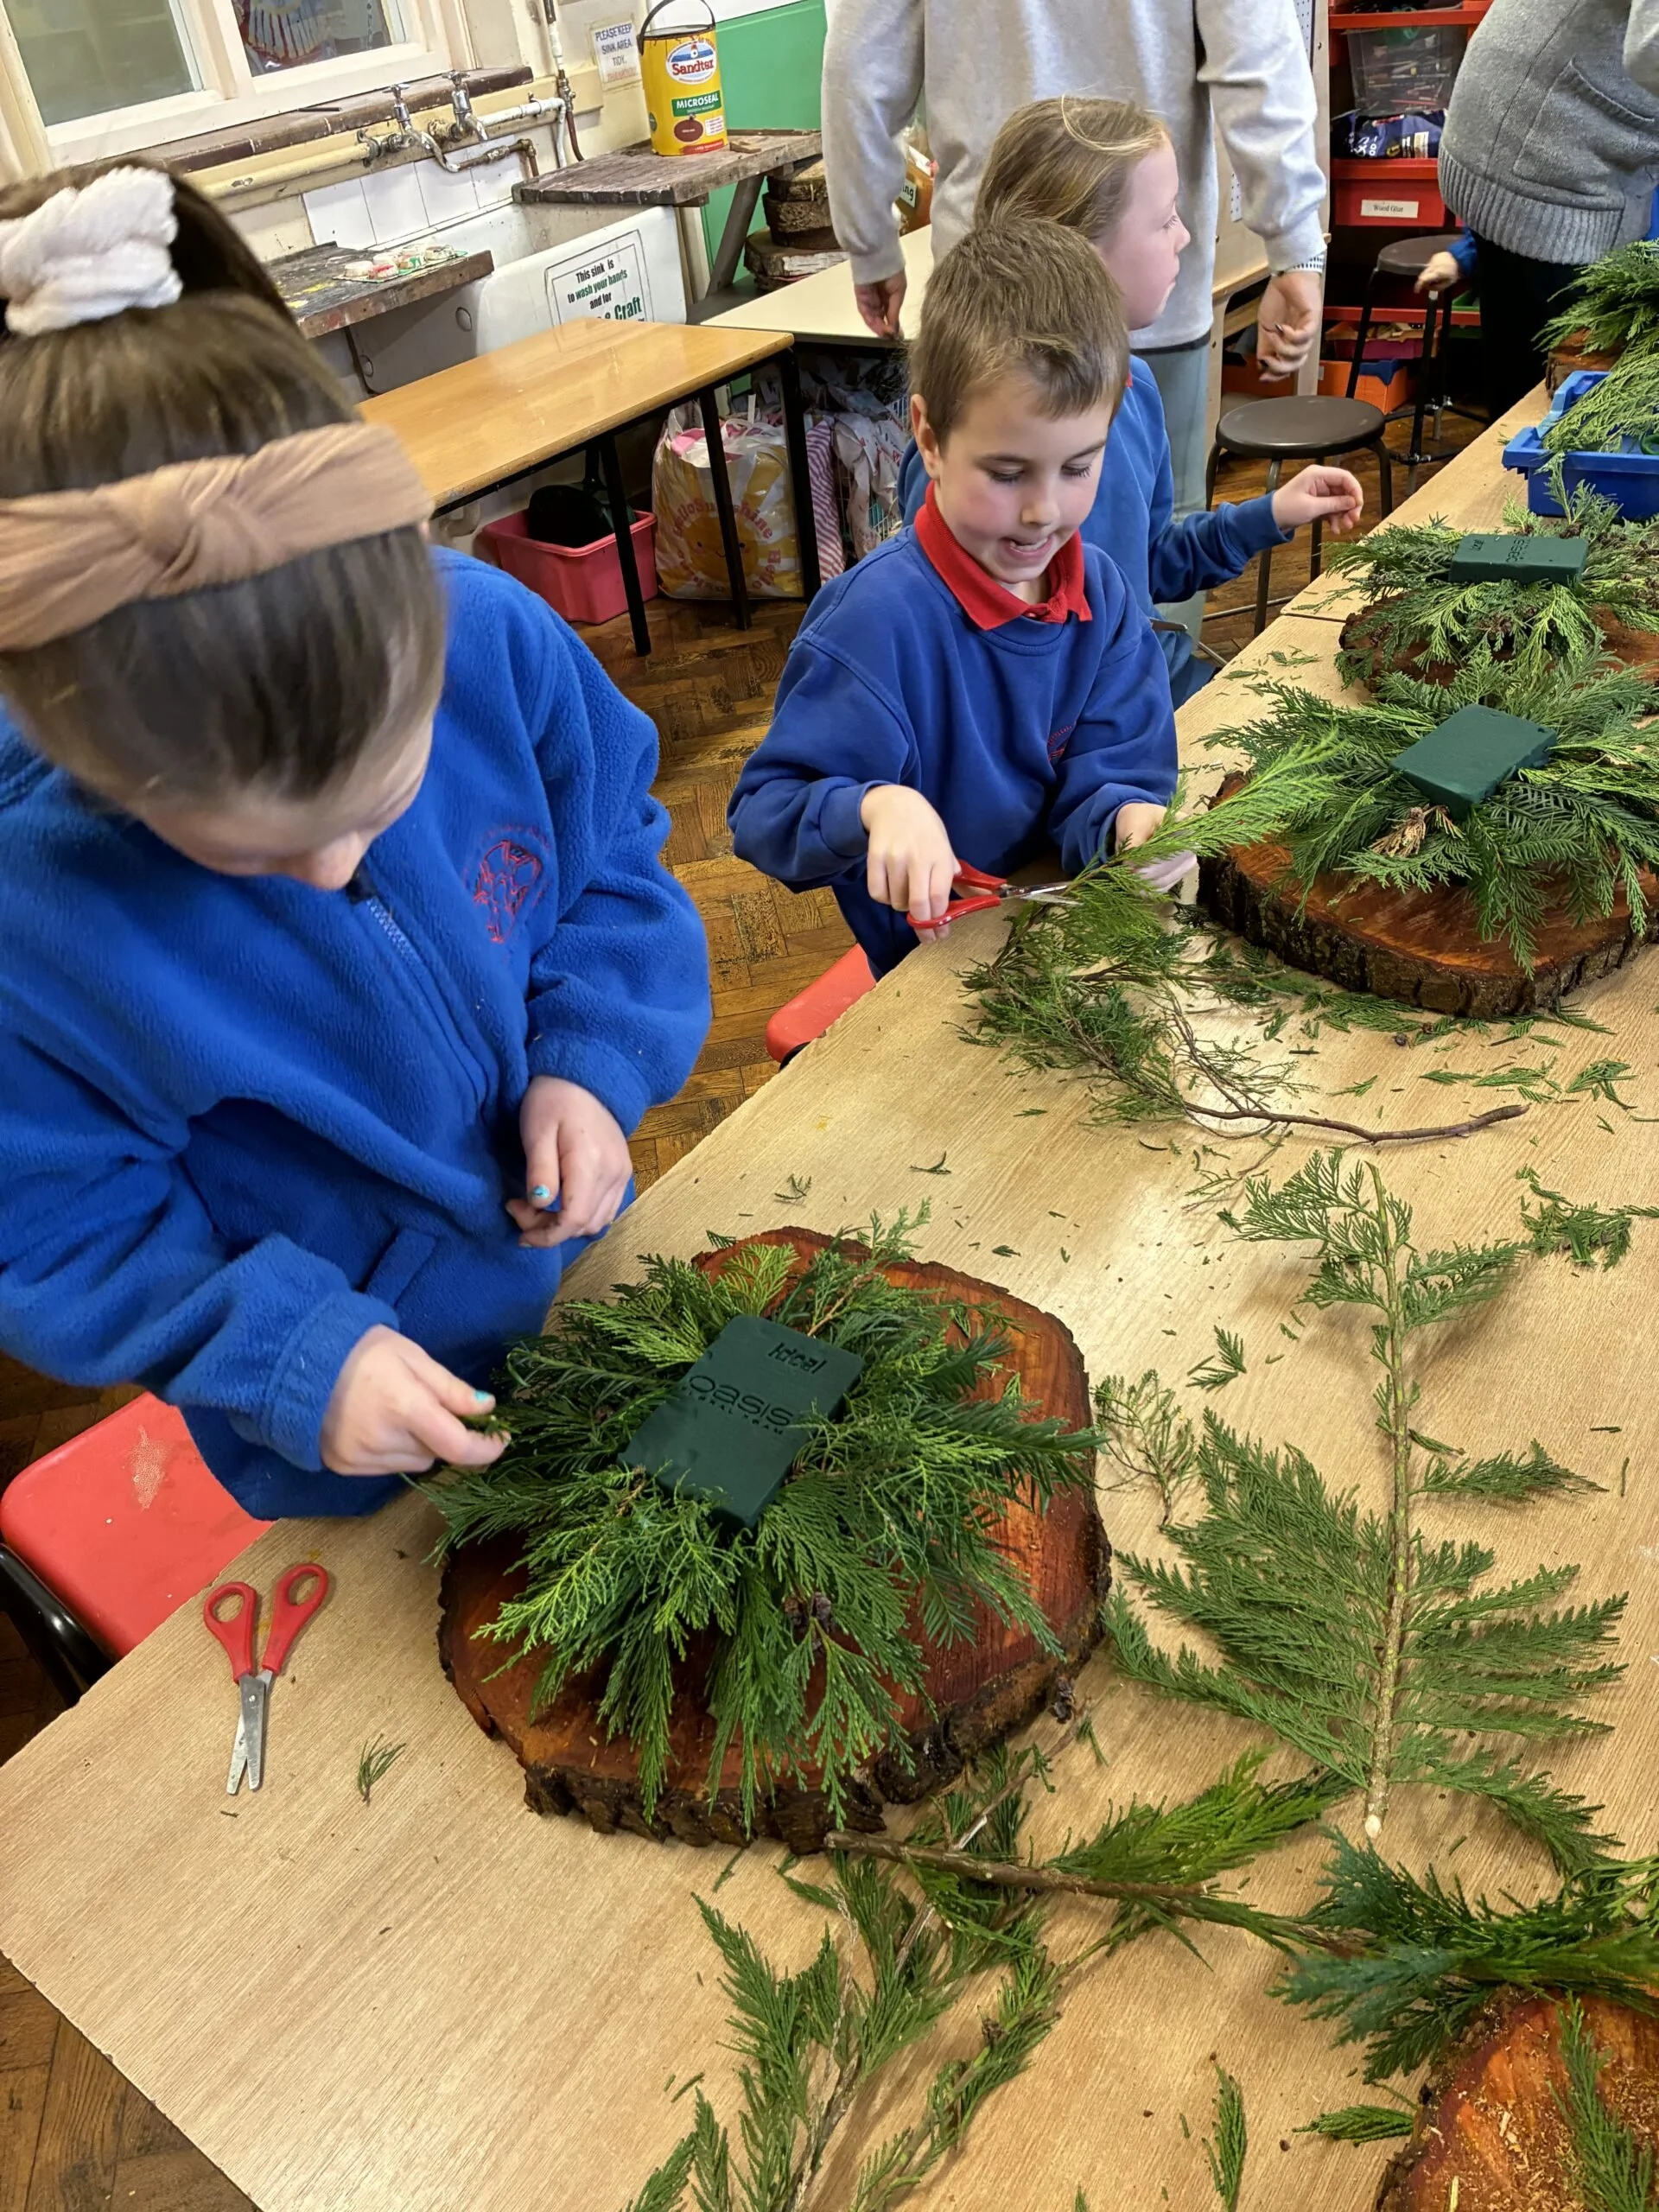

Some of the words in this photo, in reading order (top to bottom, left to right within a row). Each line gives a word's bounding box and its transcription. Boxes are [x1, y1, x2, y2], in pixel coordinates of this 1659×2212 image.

[595, 26, 619, 41] PLEASE
[618, 23, 632, 35] KEEP
[601, 43, 617, 54] SINK
[617, 38, 632, 51] AREA
[672, 60, 715, 76] Sandtex
[677, 92, 719, 109] MICROSEAL
[575, 270, 591, 283] This
[591, 263, 605, 277] sink
[607, 259, 614, 270] is
[568, 293, 575, 303] to
[575, 284, 594, 300] wash
[593, 278, 607, 293] your
[608, 270, 627, 284] hands
[589, 295, 602, 309] and
[602, 292, 612, 304] for
[614, 296, 642, 320] Craft
[768, 1342, 828, 1374] Ideal
